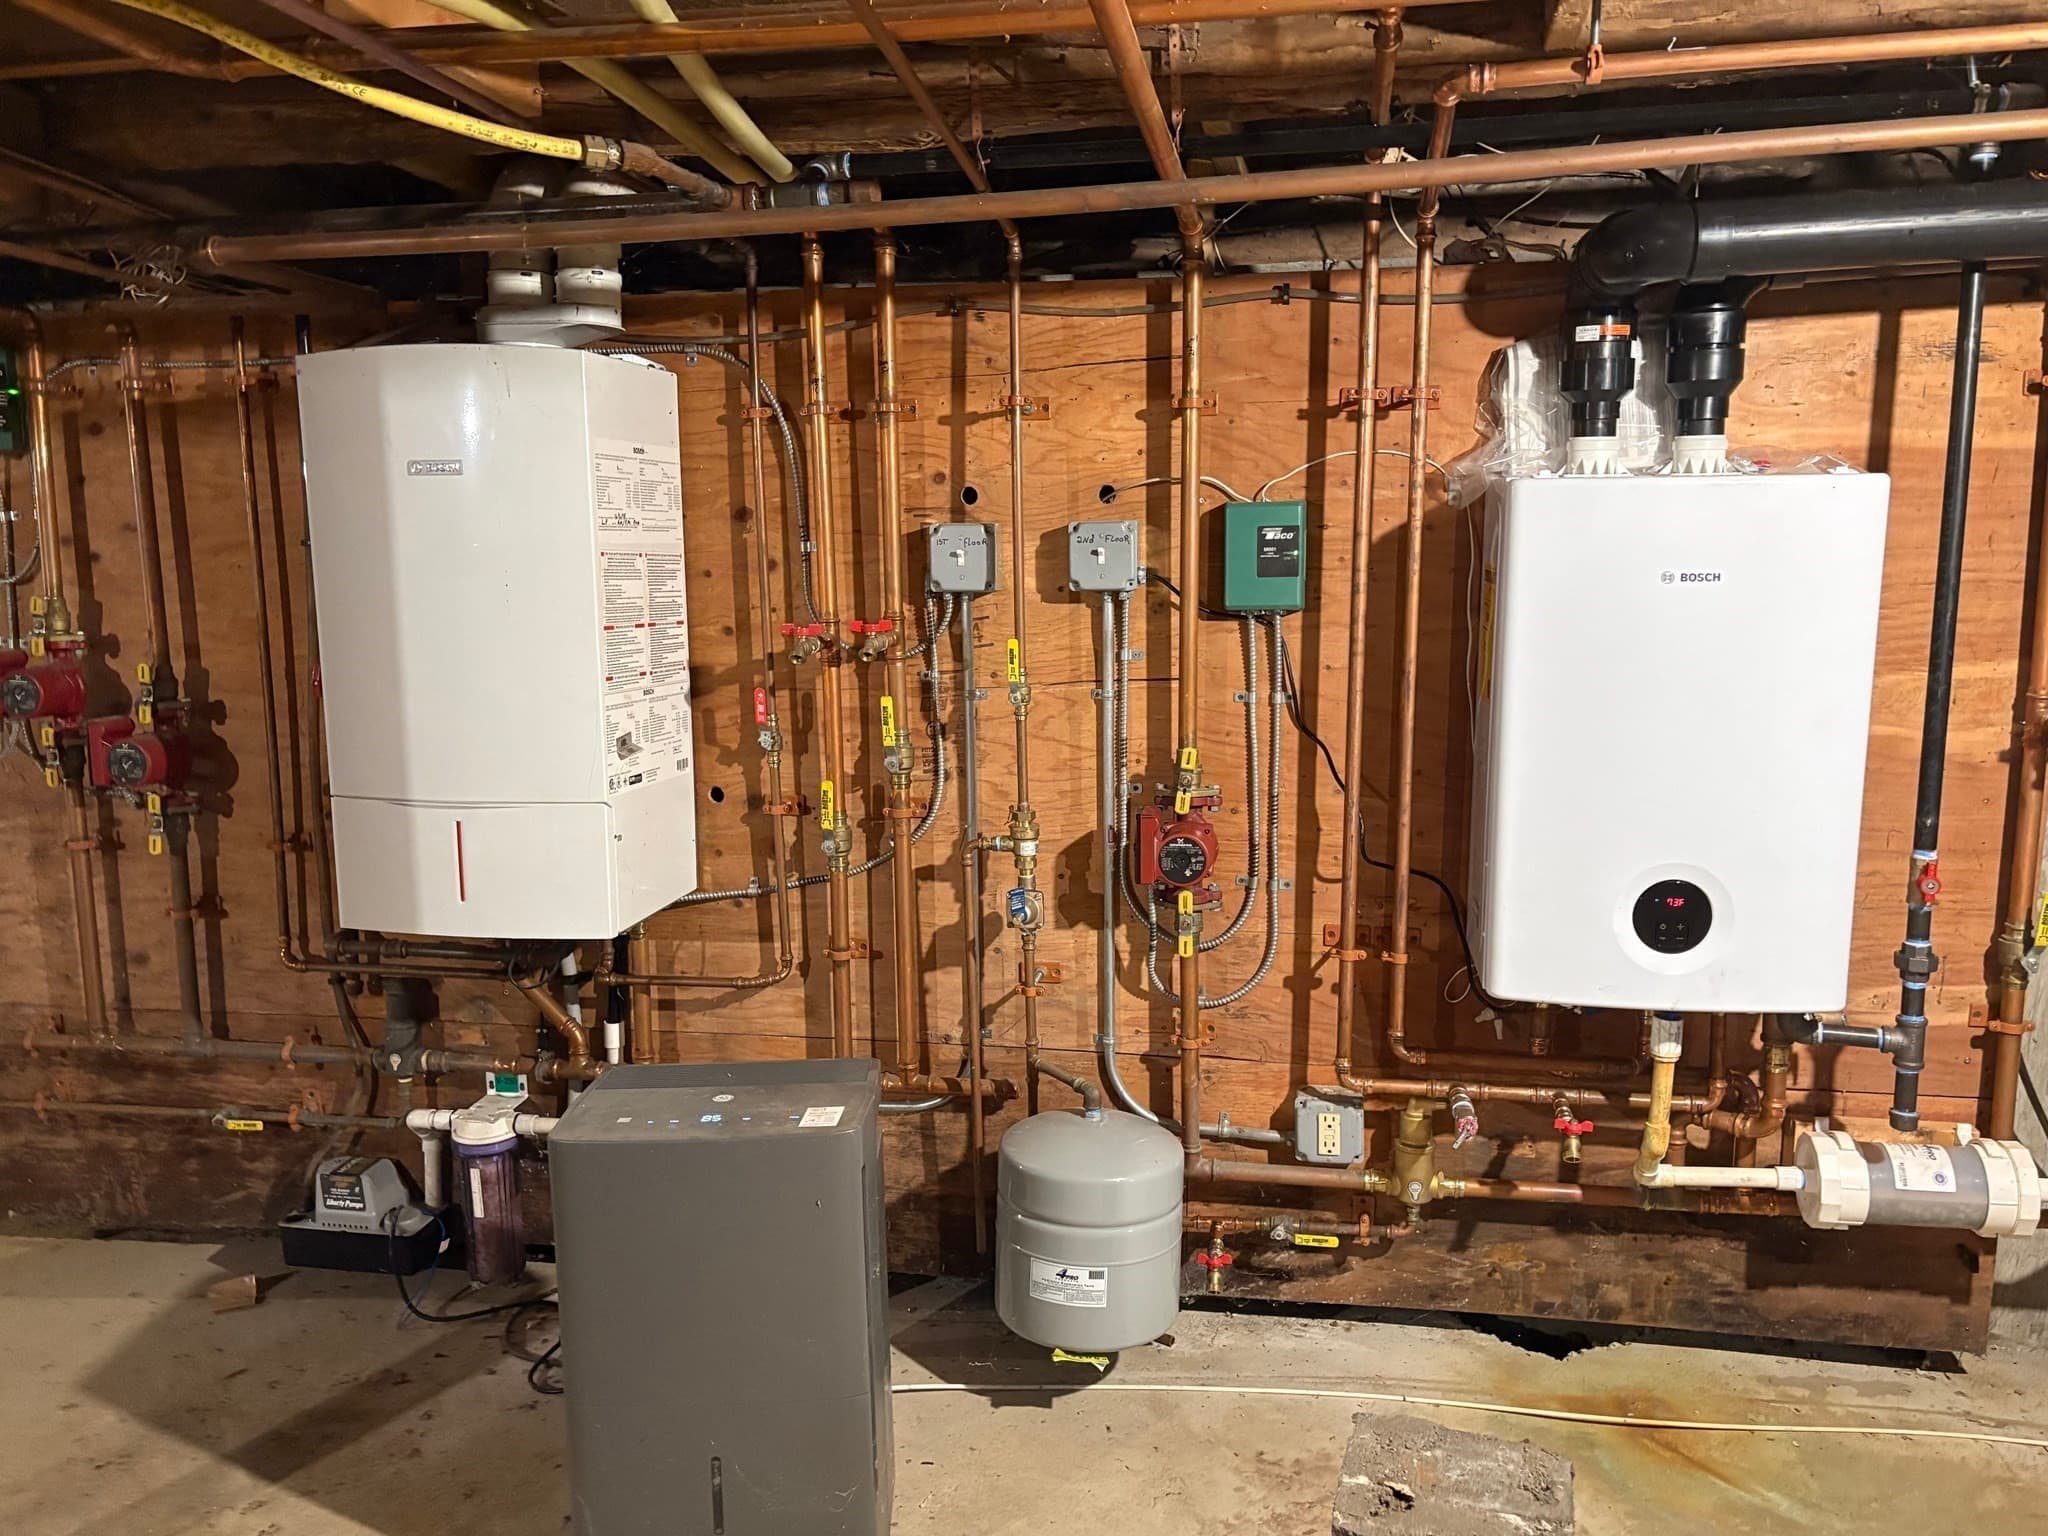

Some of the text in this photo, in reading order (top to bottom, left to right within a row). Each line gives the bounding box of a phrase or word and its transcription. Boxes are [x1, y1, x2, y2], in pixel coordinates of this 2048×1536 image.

[1261, 527, 1294, 540] Taco
[1104, 534, 1130, 544] FLOOR
[1680, 573, 1721, 582] BOSCH
[326, 1198, 364, 1209] Liberty Pumps
